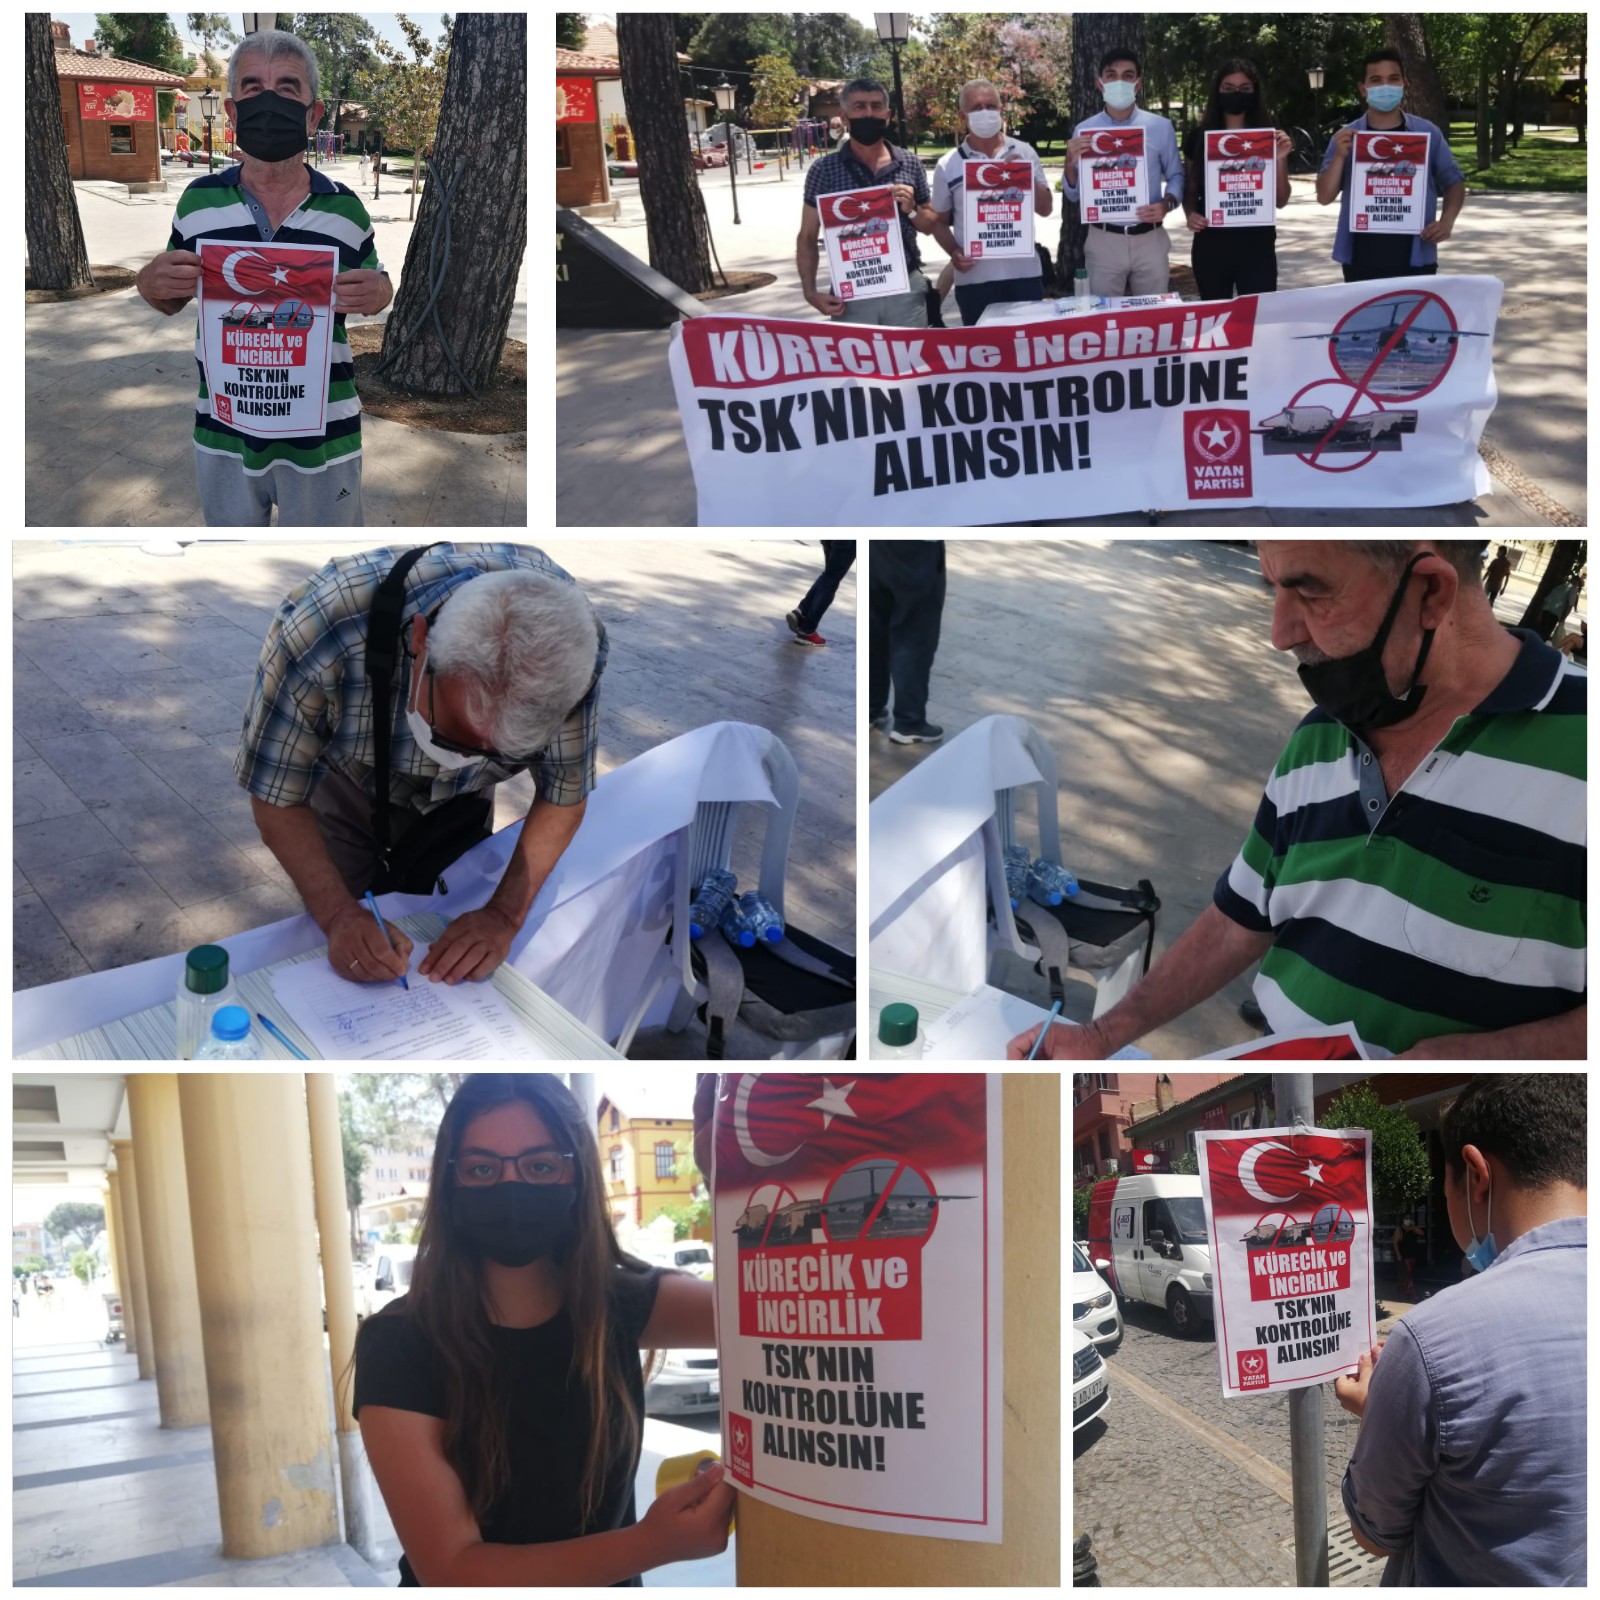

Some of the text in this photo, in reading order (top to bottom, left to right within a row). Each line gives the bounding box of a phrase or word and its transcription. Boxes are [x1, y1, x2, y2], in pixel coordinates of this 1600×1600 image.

[226, 330, 303, 348] KÜRECİK ve
[707, 311, 1232, 383] KÜRECİK ve İNCİRLİK
[235, 347, 294, 365] İNCİRLİK
[238, 367, 289, 383] TSK'NIN
[224, 381, 305, 400] KONTROLÜNE
[697, 356, 1248, 454] TSK'NIN KONTROLÜNE
[236, 399, 291, 417] ALINSIN!
[874, 420, 1091, 497] ALINSIN!
[1194, 465, 1244, 478] VATAN
[743, 1249, 908, 1293] KÜRECİK ve
[1253, 1247, 1347, 1277] KÜRECİK ve
[1268, 1268, 1340, 1297] İNCİRLİK
[757, 1292, 884, 1335] İNCİRLİK
[1274, 1293, 1336, 1320] TSK'NIN
[1255, 1310, 1351, 1345] KONTROLÜNE
[762, 1343, 875, 1384] TSK'NIN
[1277, 1334, 1340, 1364] ALINSIN!
[1242, 1373, 1266, 1382] VATAN
[742, 1379, 926, 1430] KONTROLÜNE
[763, 1422, 886, 1472] ALINSIN!
